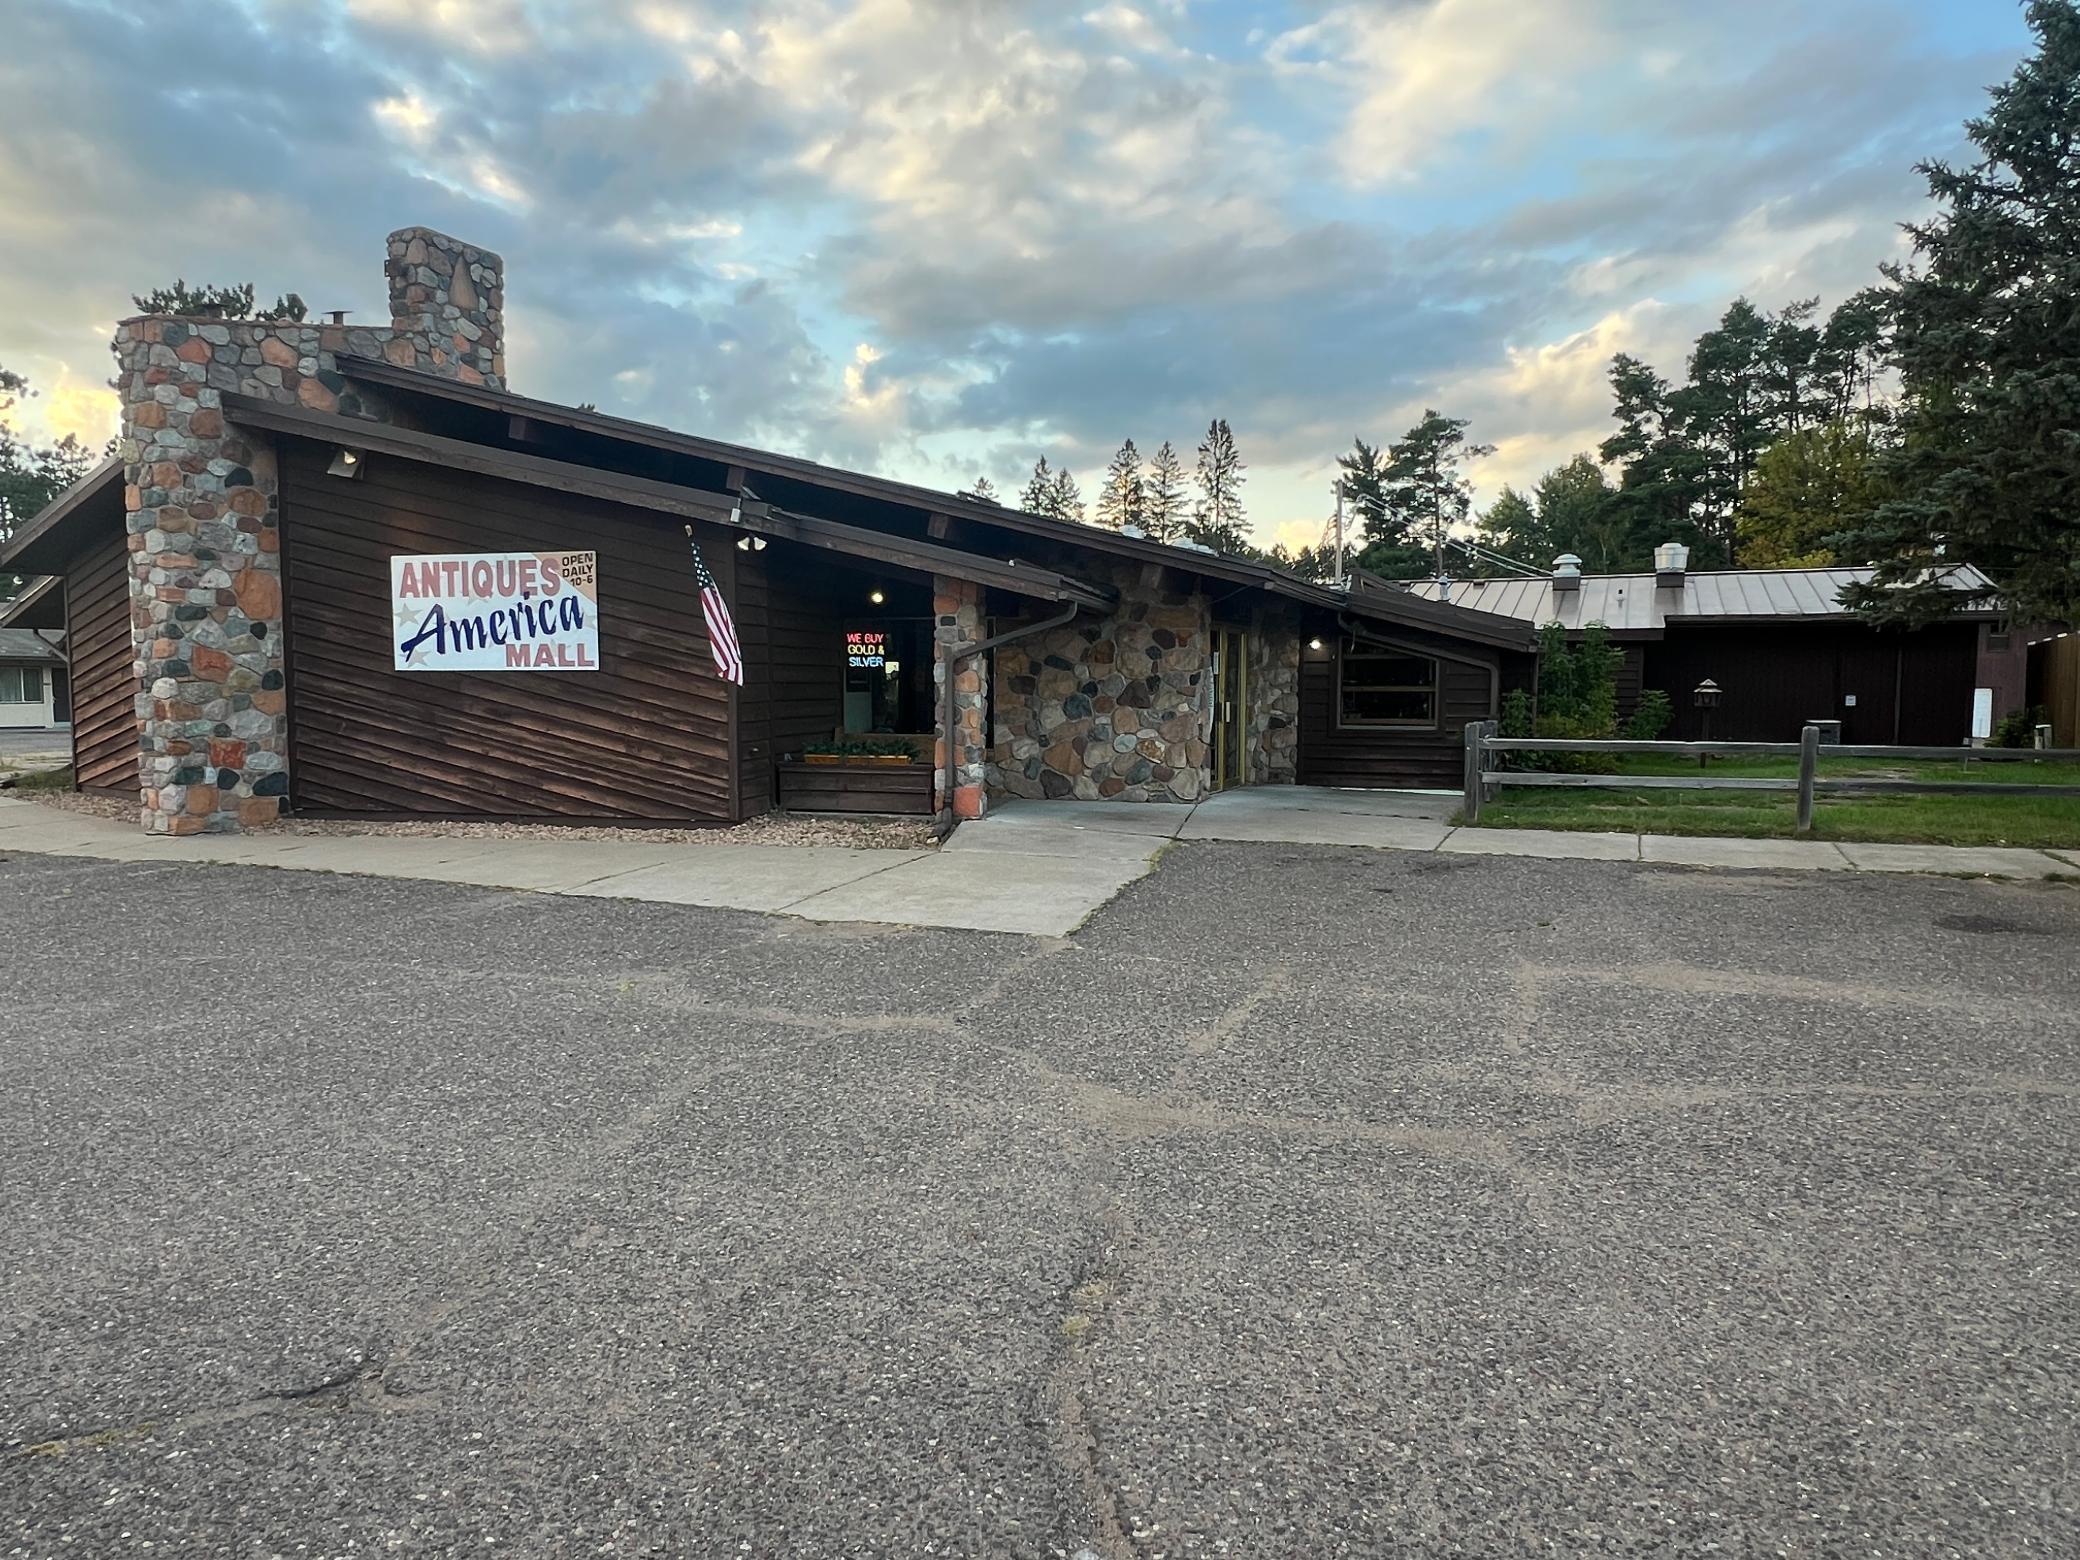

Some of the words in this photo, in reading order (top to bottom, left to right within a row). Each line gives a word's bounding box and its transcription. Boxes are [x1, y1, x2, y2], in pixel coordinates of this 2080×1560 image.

[562, 553, 593, 566] OPEN
[562, 564, 593, 577] DAILY
[400, 559, 561, 598] ANTIQUES
[570, 575, 593, 587] 10-6
[400, 591, 584, 662] America
[847, 633, 862, 643] WE
[864, 633, 884, 644] BUY
[505, 643, 594, 667] MALL
[847, 644, 876, 655] GOLD
[878, 645, 885, 655] &
[848, 656, 884, 667] SILVER
